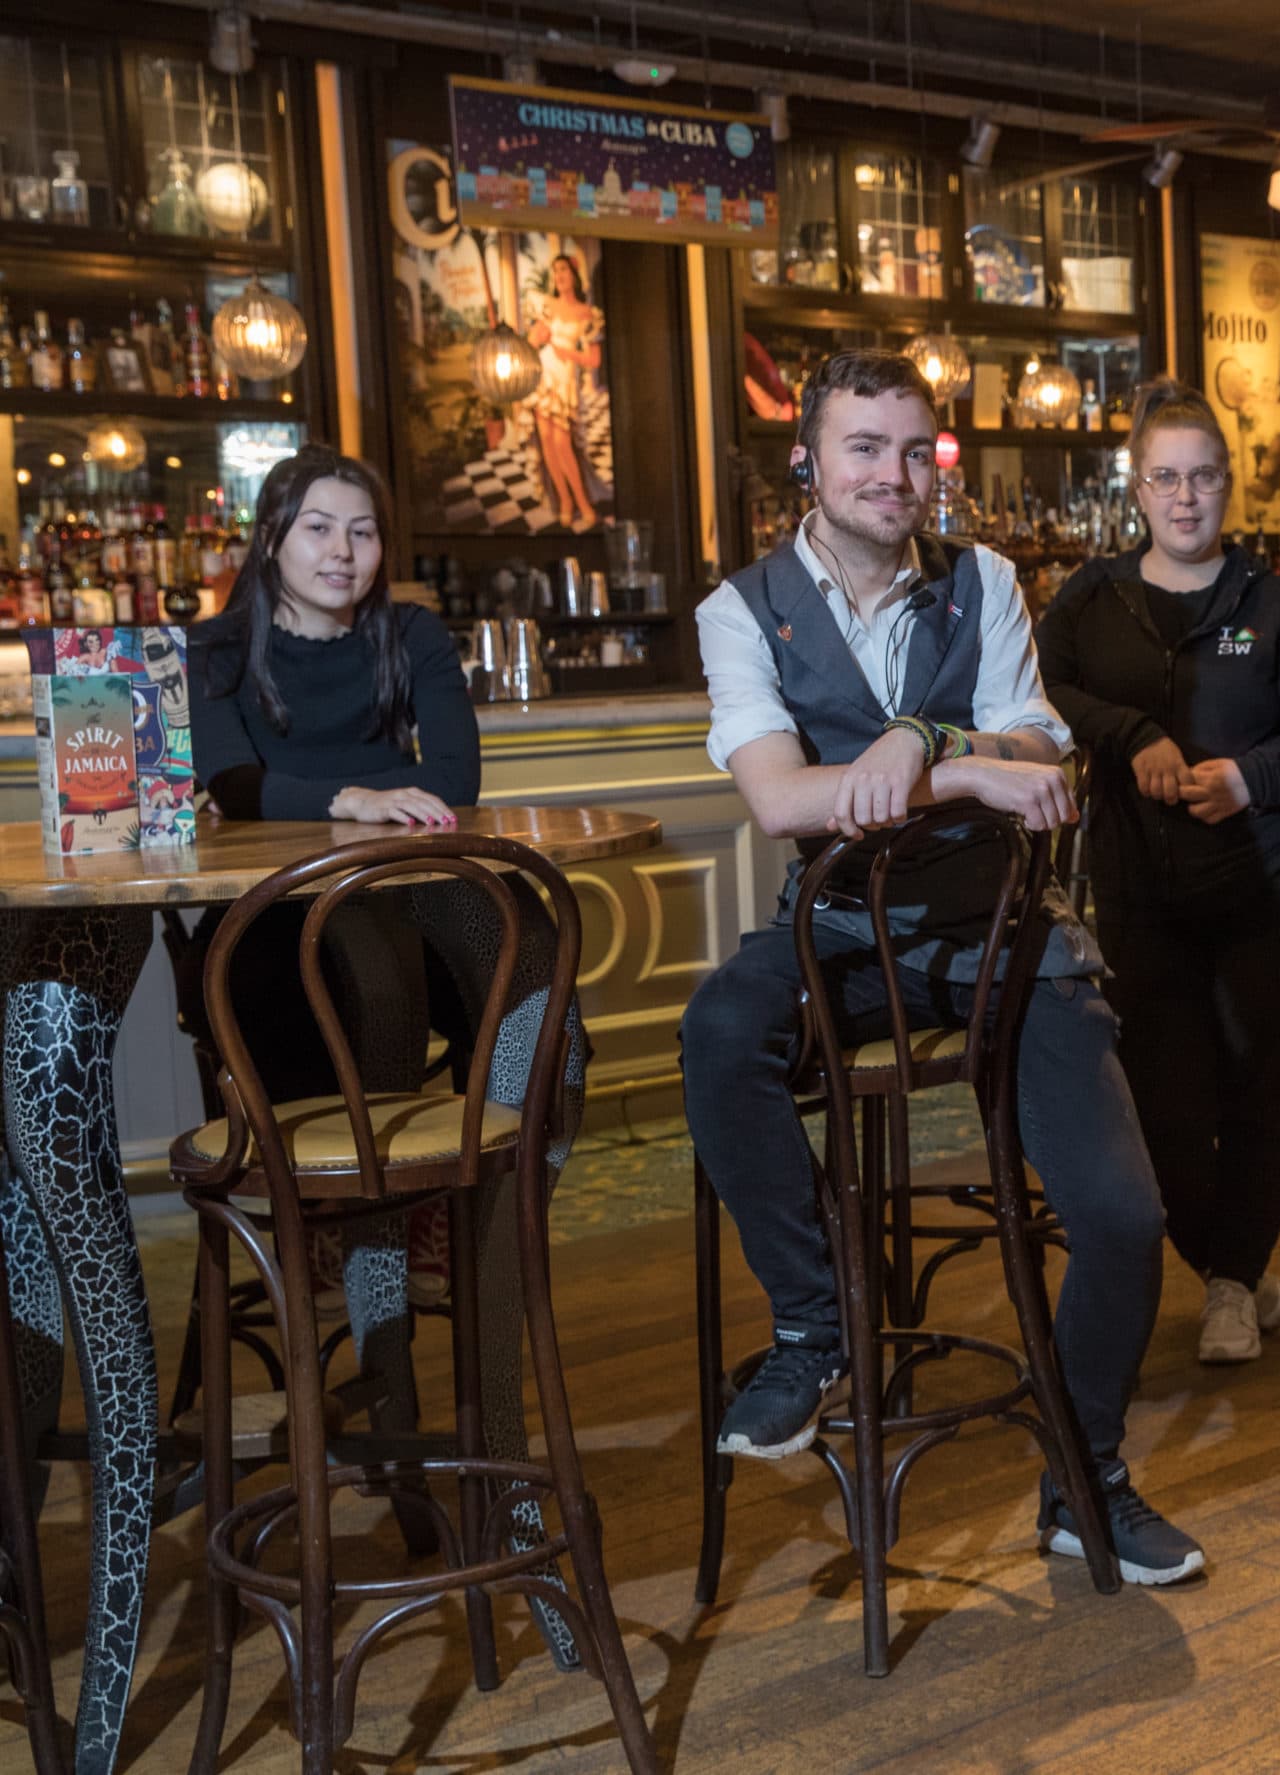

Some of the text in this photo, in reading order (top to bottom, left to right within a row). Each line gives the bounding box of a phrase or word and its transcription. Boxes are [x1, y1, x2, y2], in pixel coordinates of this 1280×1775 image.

[518, 103, 646, 138] CHRISTMAS
[660, 120, 717, 148] CUBA
[66, 727, 124, 752] SPIRIT
[64, 756, 128, 774] JAMAICA
